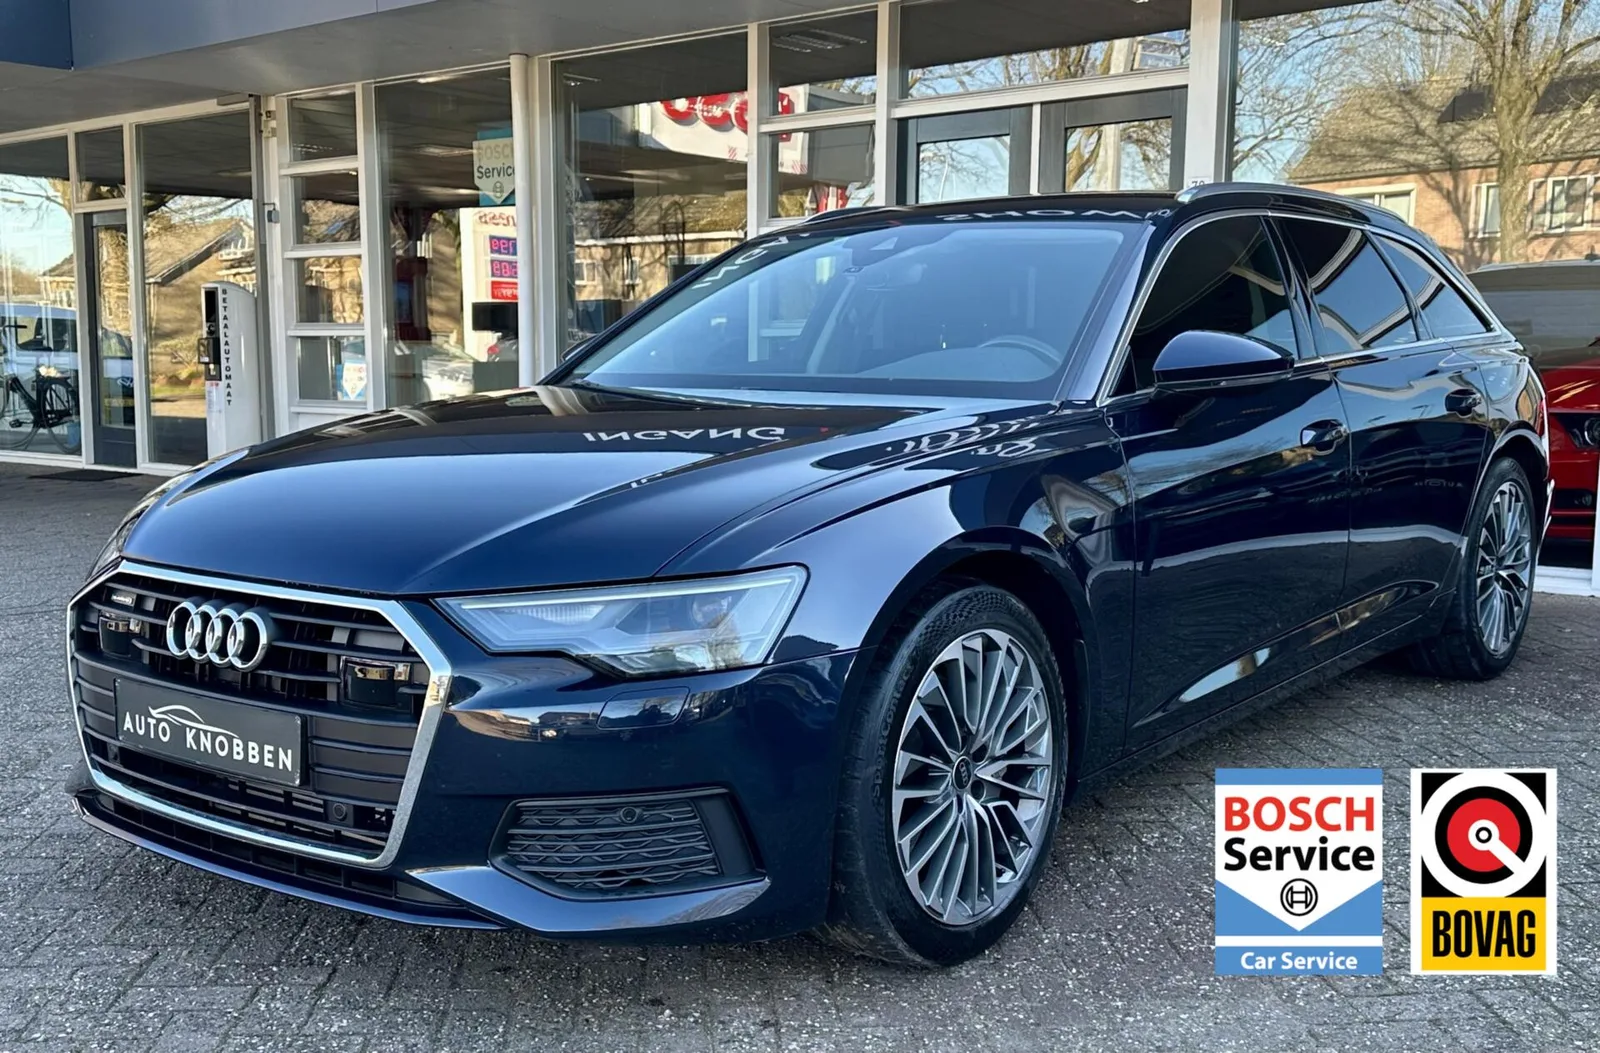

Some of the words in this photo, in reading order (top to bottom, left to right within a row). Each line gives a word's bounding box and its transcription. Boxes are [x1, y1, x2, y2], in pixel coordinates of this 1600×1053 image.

[476, 162, 515, 179] Servic
[477, 143, 514, 161] BOSC
[222, 289, 232, 406] BETAALAUTOMAAT
[123, 712, 171, 742] AUTO
[186, 727, 292, 772] KNOBBEN
